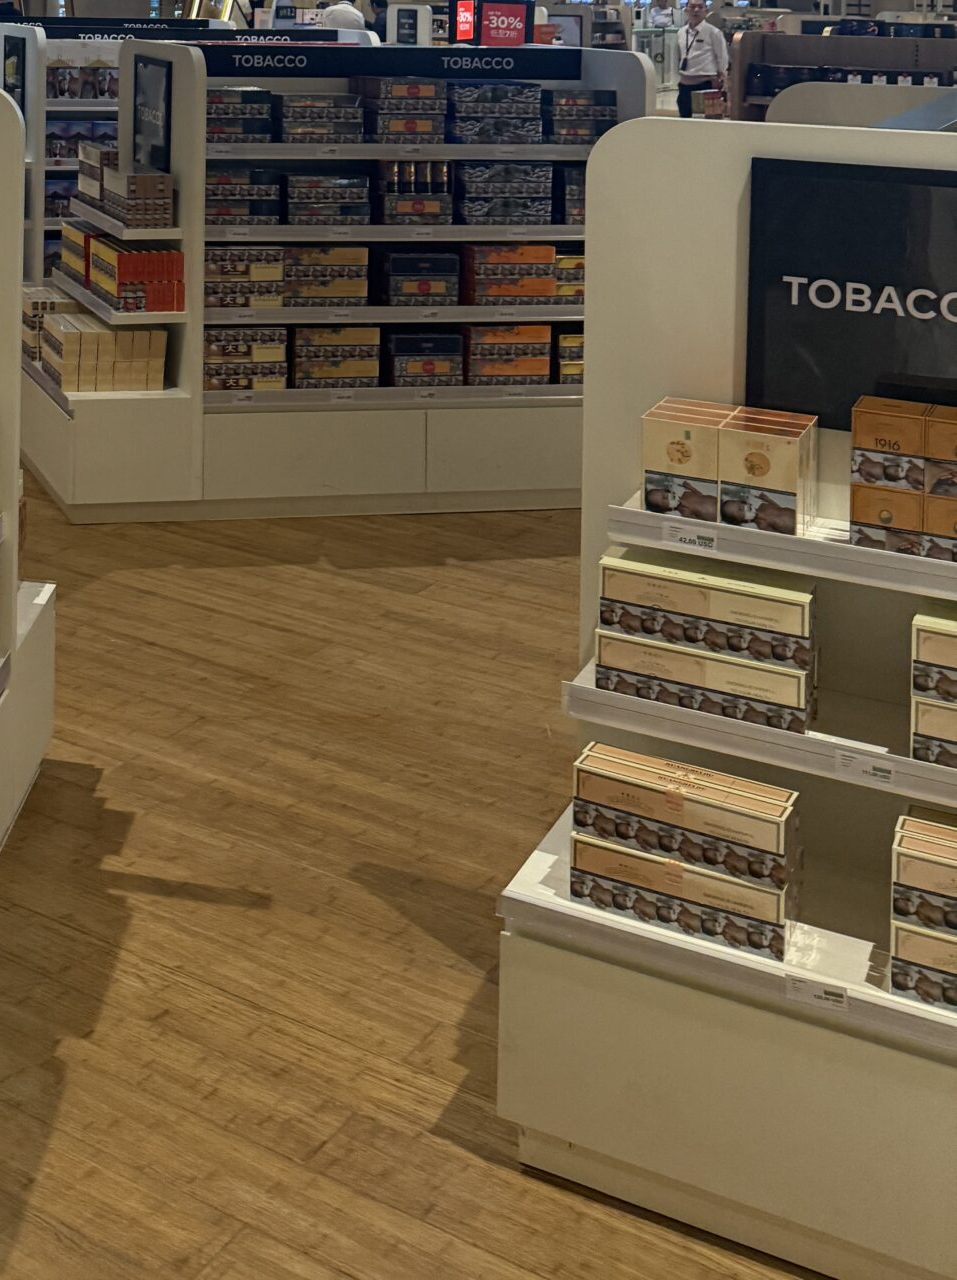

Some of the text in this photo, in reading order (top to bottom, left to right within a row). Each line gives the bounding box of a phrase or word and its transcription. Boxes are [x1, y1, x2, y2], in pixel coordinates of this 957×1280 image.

[483, 16, 523, 29] -30%
[232, 55, 308, 68] TOBACCO
[441, 56, 515, 69] TOBACCO
